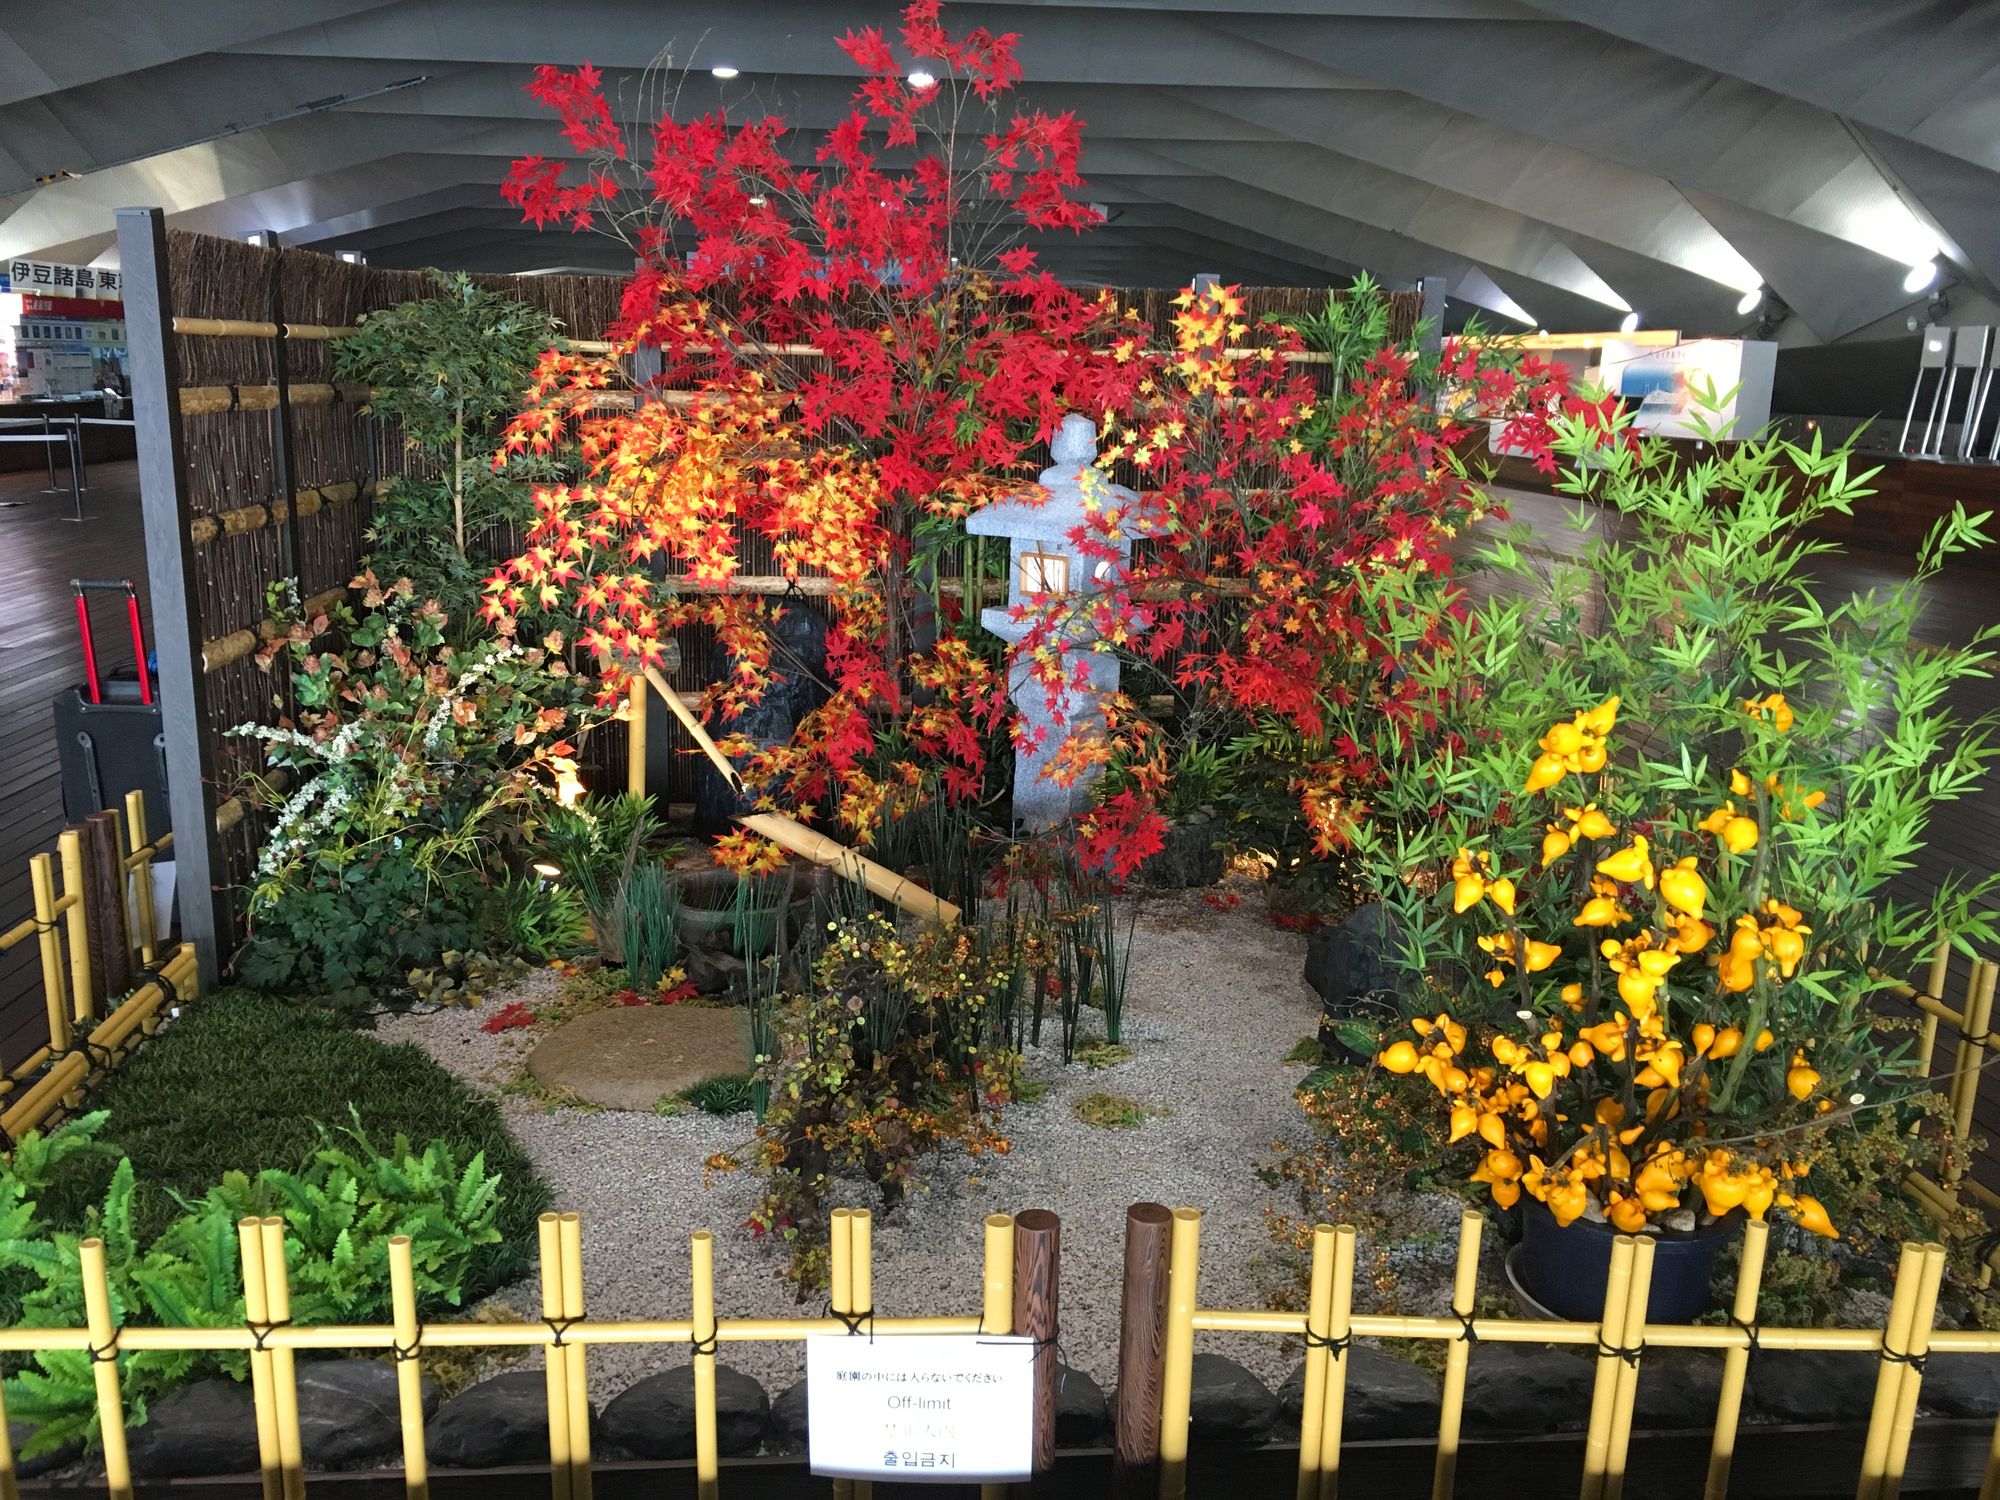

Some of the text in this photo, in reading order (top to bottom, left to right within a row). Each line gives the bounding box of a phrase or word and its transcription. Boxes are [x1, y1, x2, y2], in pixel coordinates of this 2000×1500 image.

[836, 1370, 1003, 1384] 庭園の中には入らないでください
[887, 1396, 951, 1410] Off-limit
[883, 1450, 955, 1469] 출입금지
